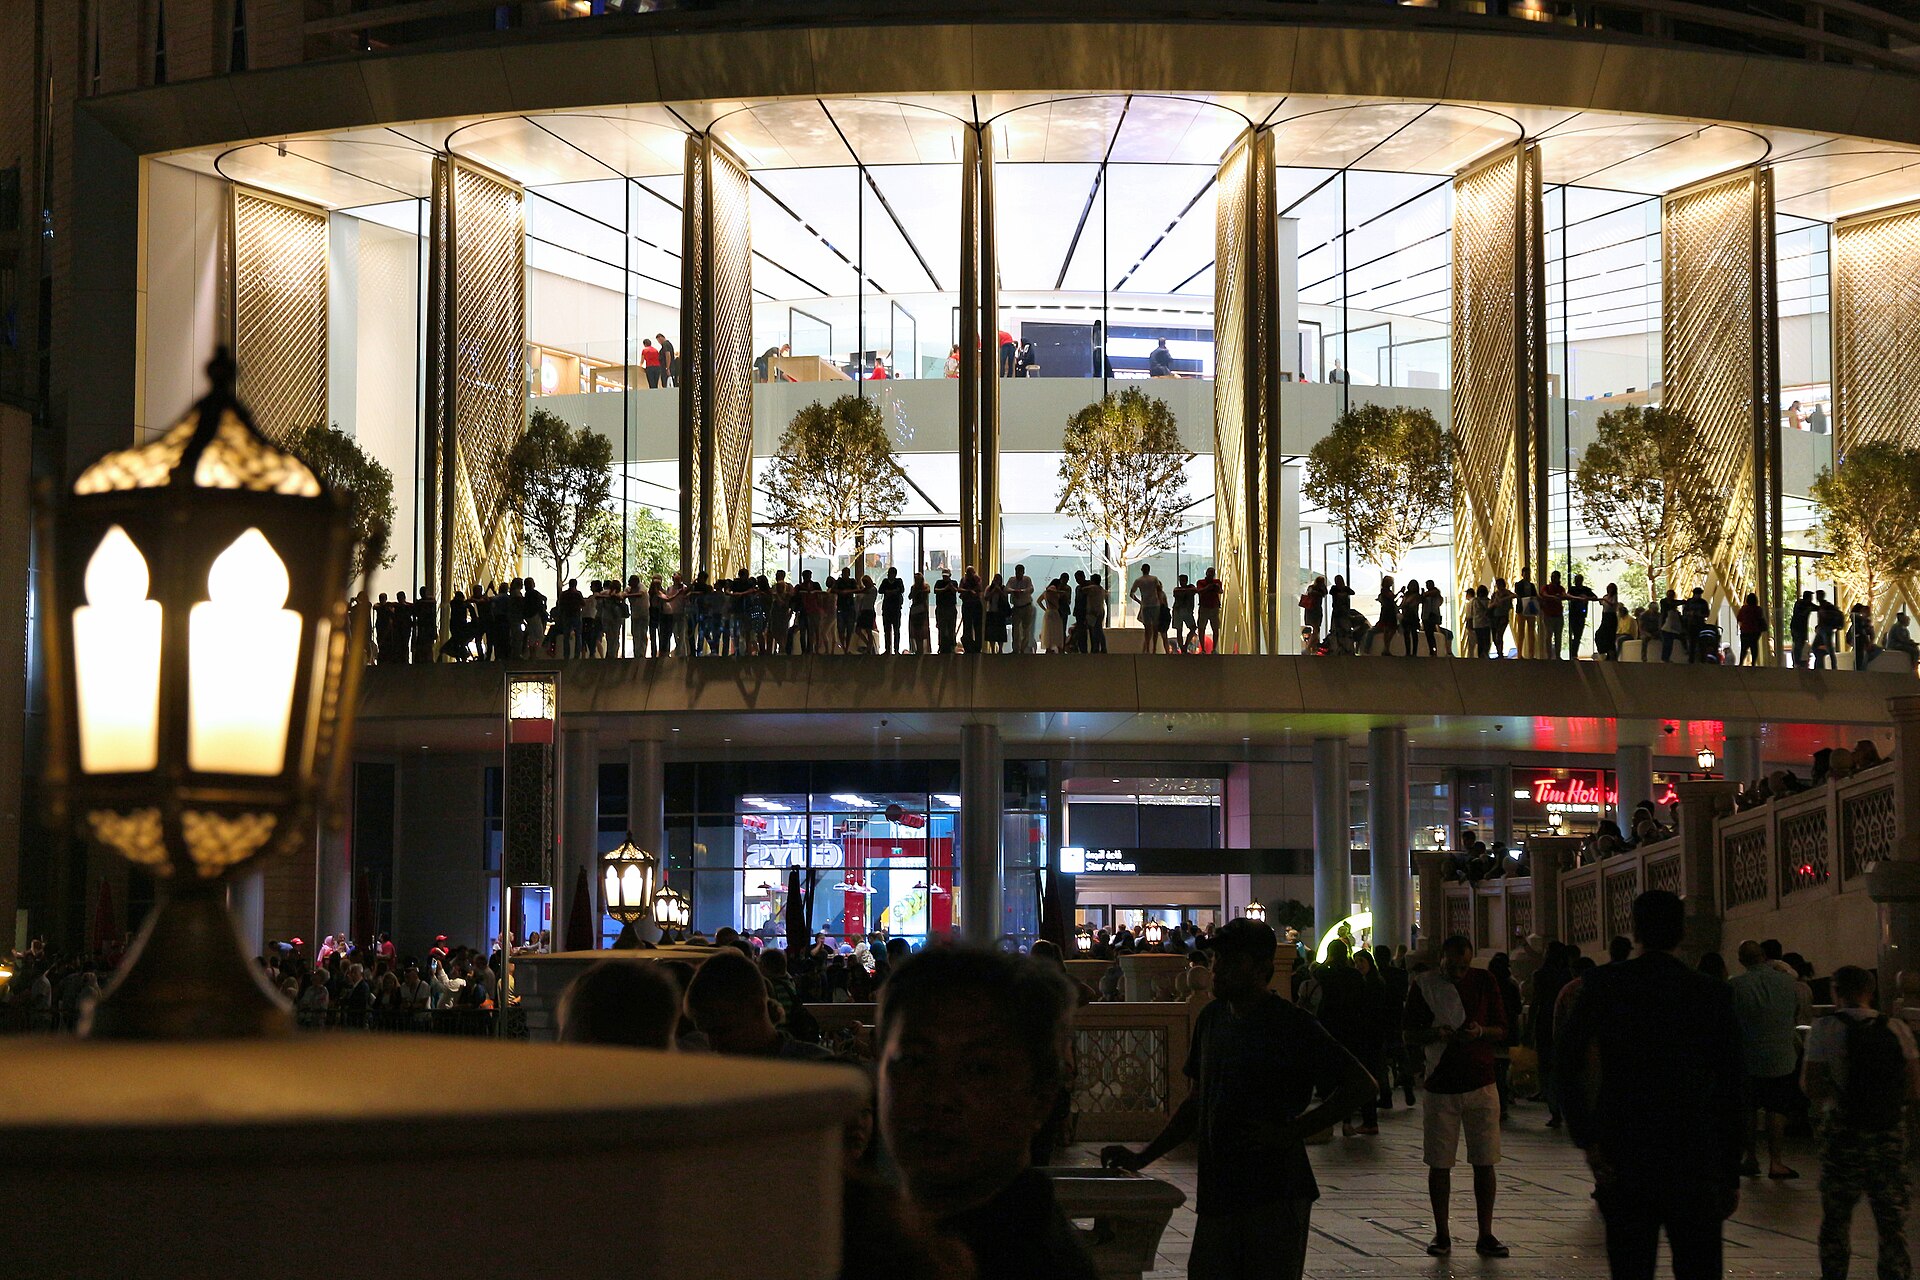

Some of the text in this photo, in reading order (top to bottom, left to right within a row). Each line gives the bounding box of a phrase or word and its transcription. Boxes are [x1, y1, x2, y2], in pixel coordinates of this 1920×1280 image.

[1534, 779, 1566, 803] Tim
[1085, 861, 1136, 871] Star Atrium
